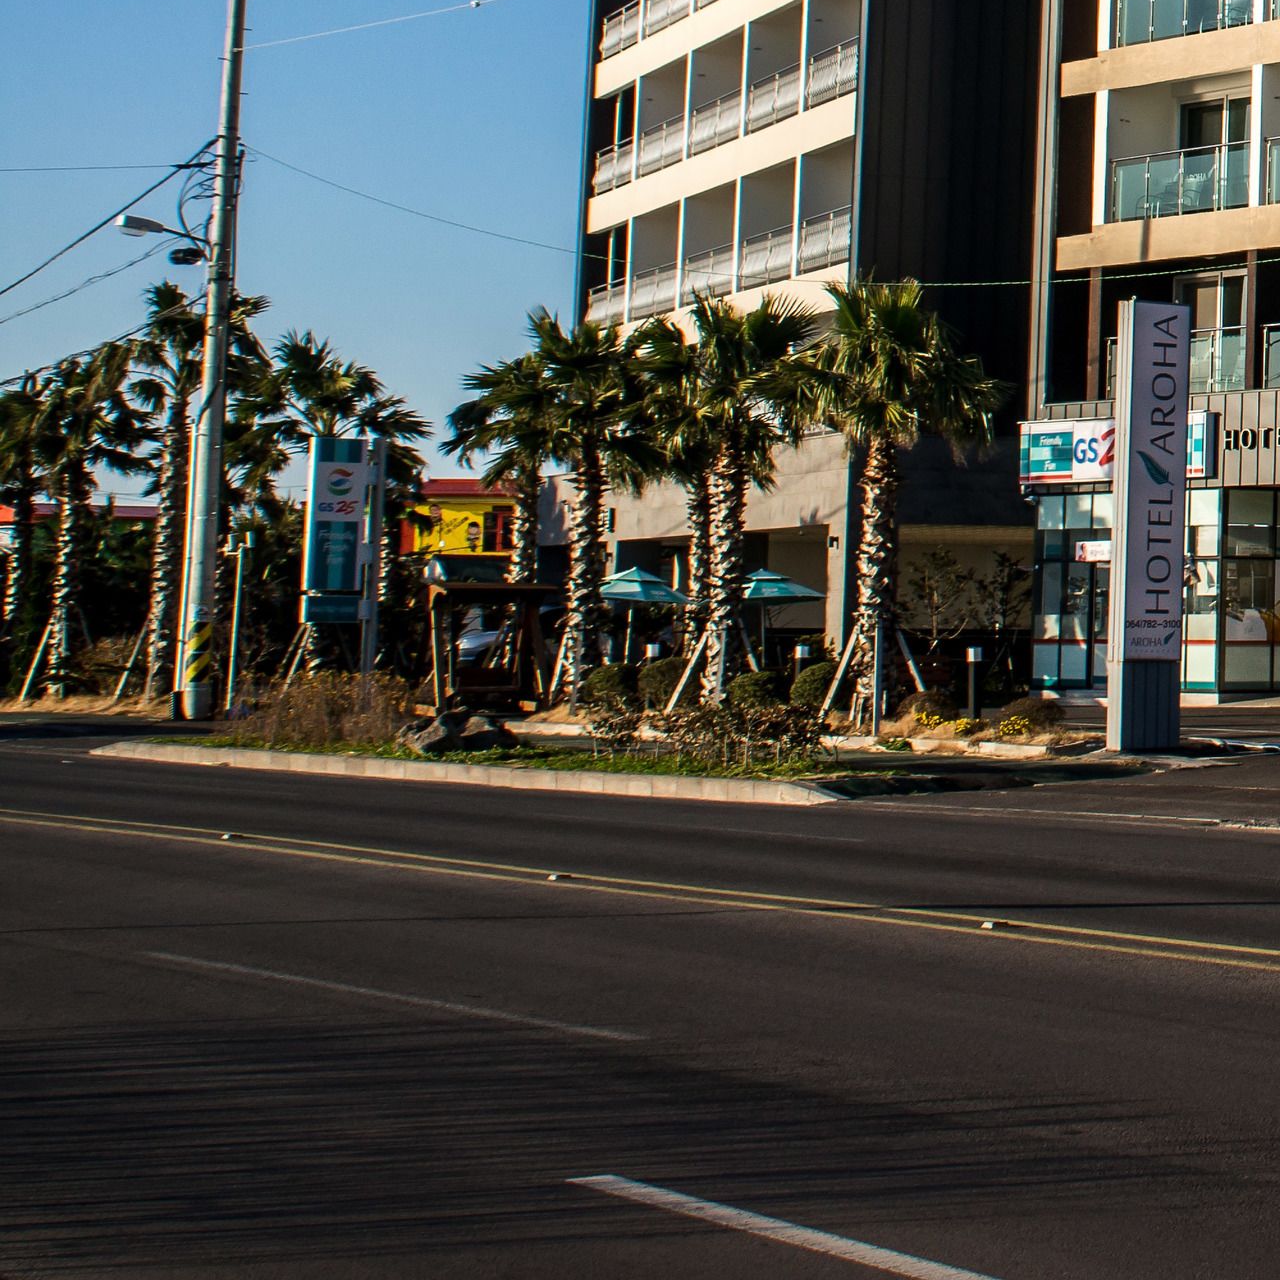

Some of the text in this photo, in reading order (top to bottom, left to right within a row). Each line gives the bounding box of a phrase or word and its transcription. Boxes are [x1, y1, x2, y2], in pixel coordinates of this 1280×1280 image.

[1150, 314, 1178, 456] AROHA
[1039, 435, 1063, 447] Friendly
[1073, 427, 1115, 466] GS2
[317, 500, 359, 515] GS25
[1145, 488, 1174, 615] HOTEL
[1130, 637, 1162, 647] AROHA
